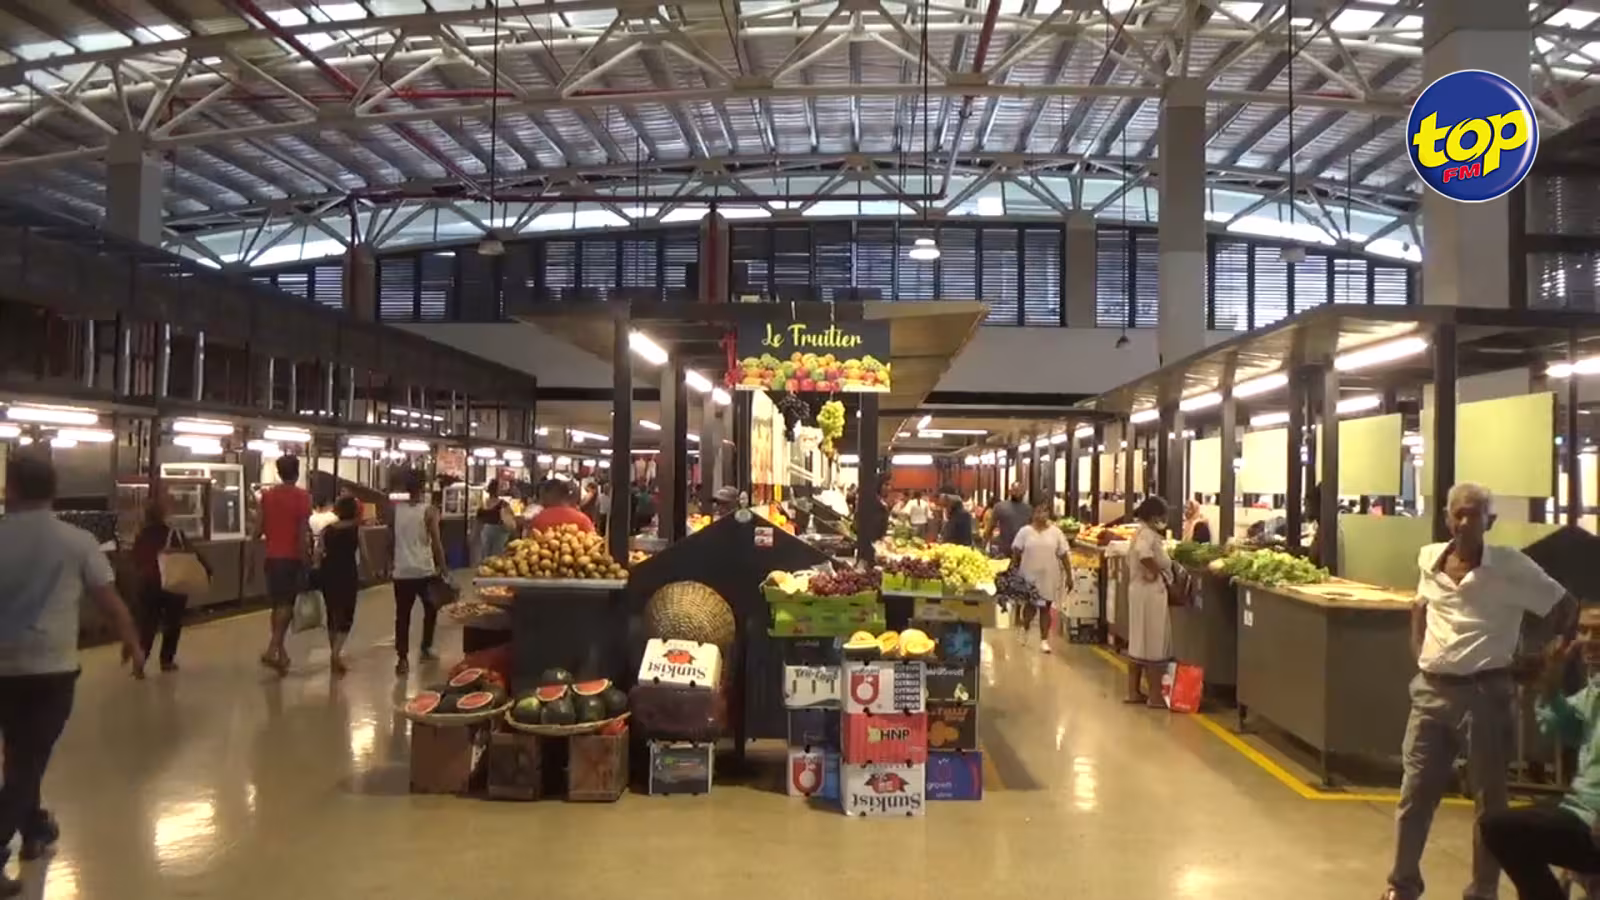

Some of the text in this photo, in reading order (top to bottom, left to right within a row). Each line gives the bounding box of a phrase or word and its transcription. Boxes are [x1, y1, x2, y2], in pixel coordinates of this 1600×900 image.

[761, 322, 785, 348] Le
[647, 661, 706, 680] Sunkist
[880, 729, 911, 741] HNP
[852, 793, 921, 812] Sunkist
